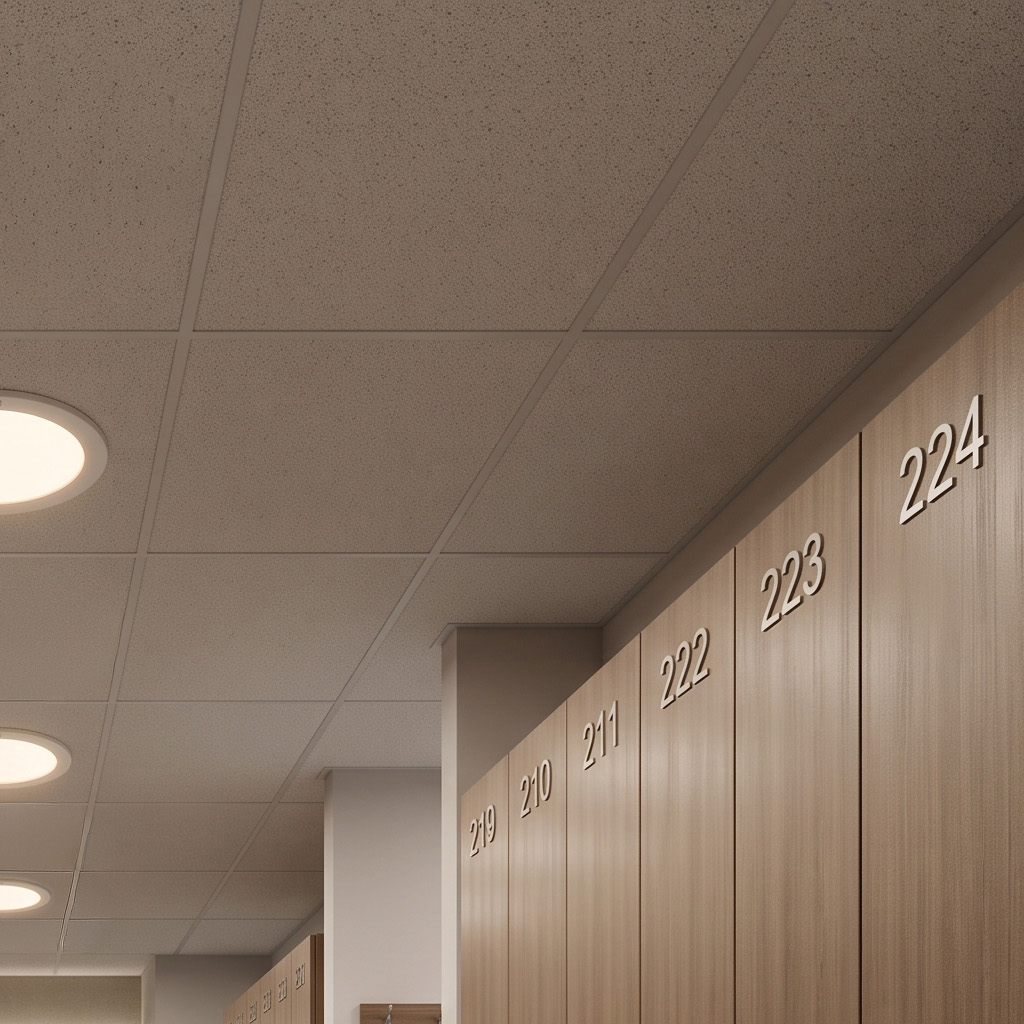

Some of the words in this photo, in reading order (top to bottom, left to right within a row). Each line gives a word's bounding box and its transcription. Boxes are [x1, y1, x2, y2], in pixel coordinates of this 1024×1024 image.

[899, 394, 988, 525] 224
[760, 531, 826, 632] 223
[659, 627, 710, 710] 222
[583, 700, 618, 770] 211
[519, 758, 552, 819] 210
[469, 804, 496, 857] 219
